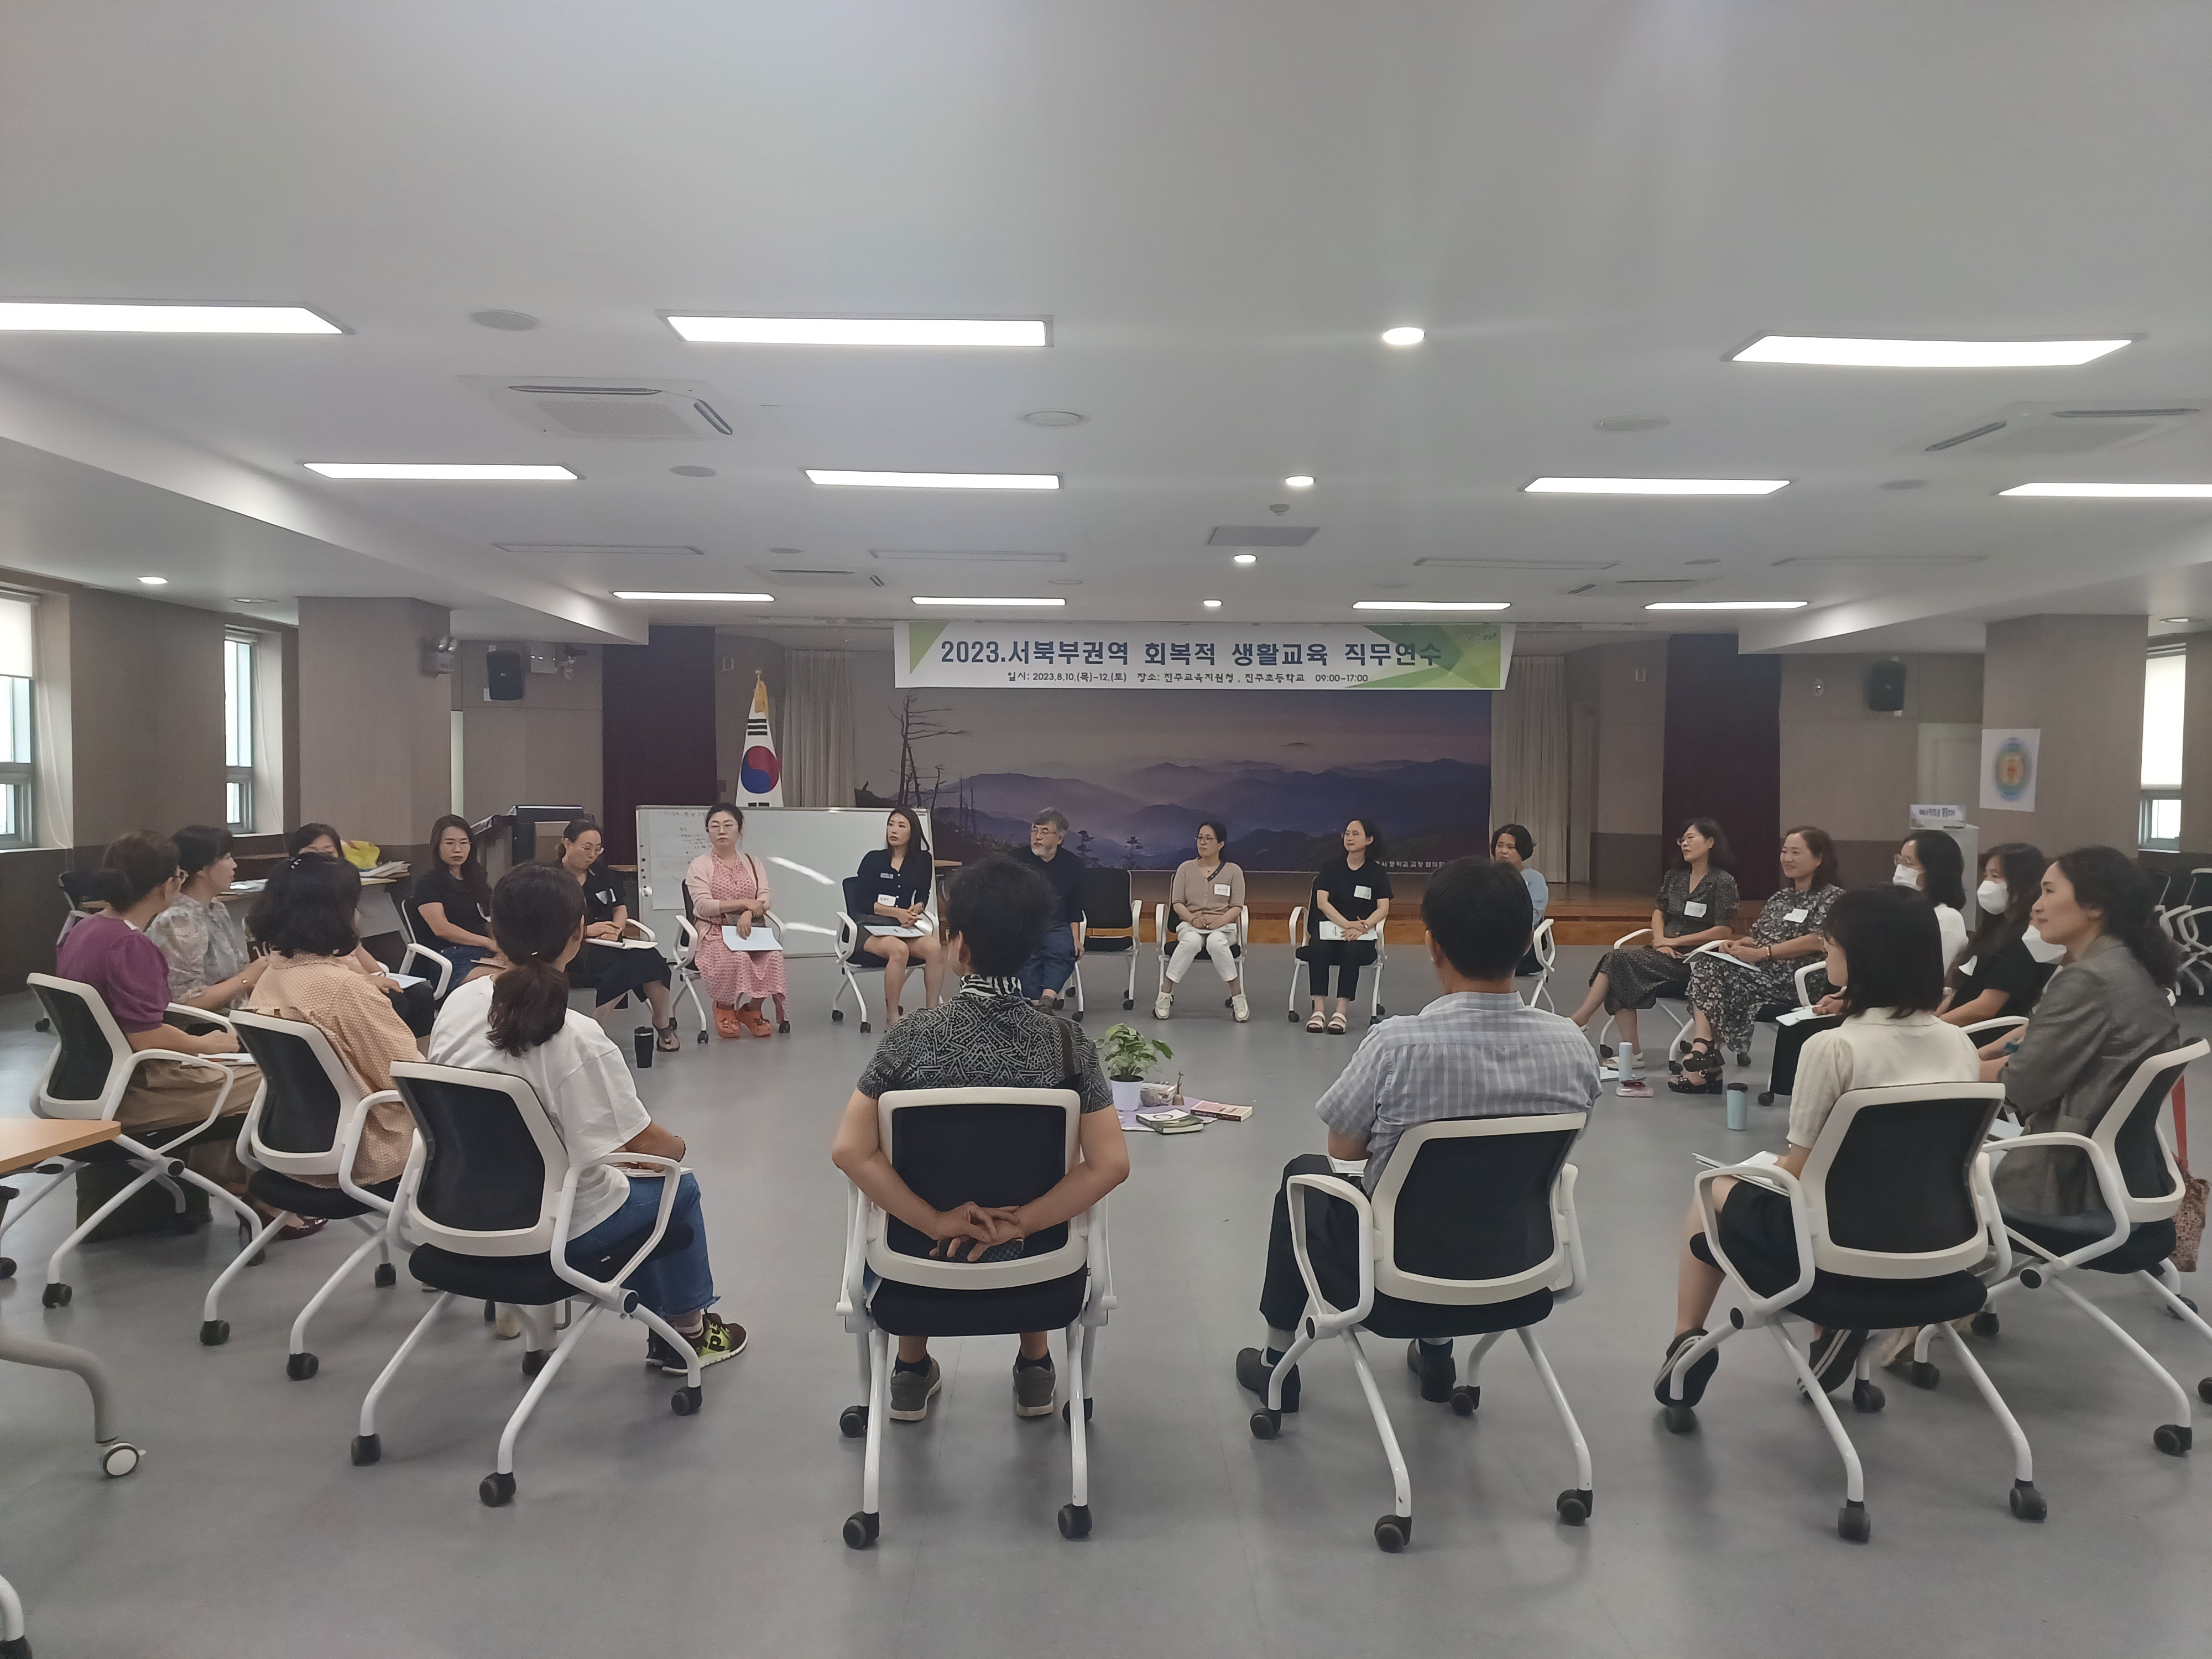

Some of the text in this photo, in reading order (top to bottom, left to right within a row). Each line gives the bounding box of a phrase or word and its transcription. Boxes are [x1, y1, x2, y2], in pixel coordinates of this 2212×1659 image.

[941, 640, 1442, 667] 2023.서북부권역 회복적 생활교육 직무연수
[1008, 671, 1030, 682] 일시:
[1137, 672, 1160, 683] 장소:
[1244, 673, 1306, 684] 진주초등학교
